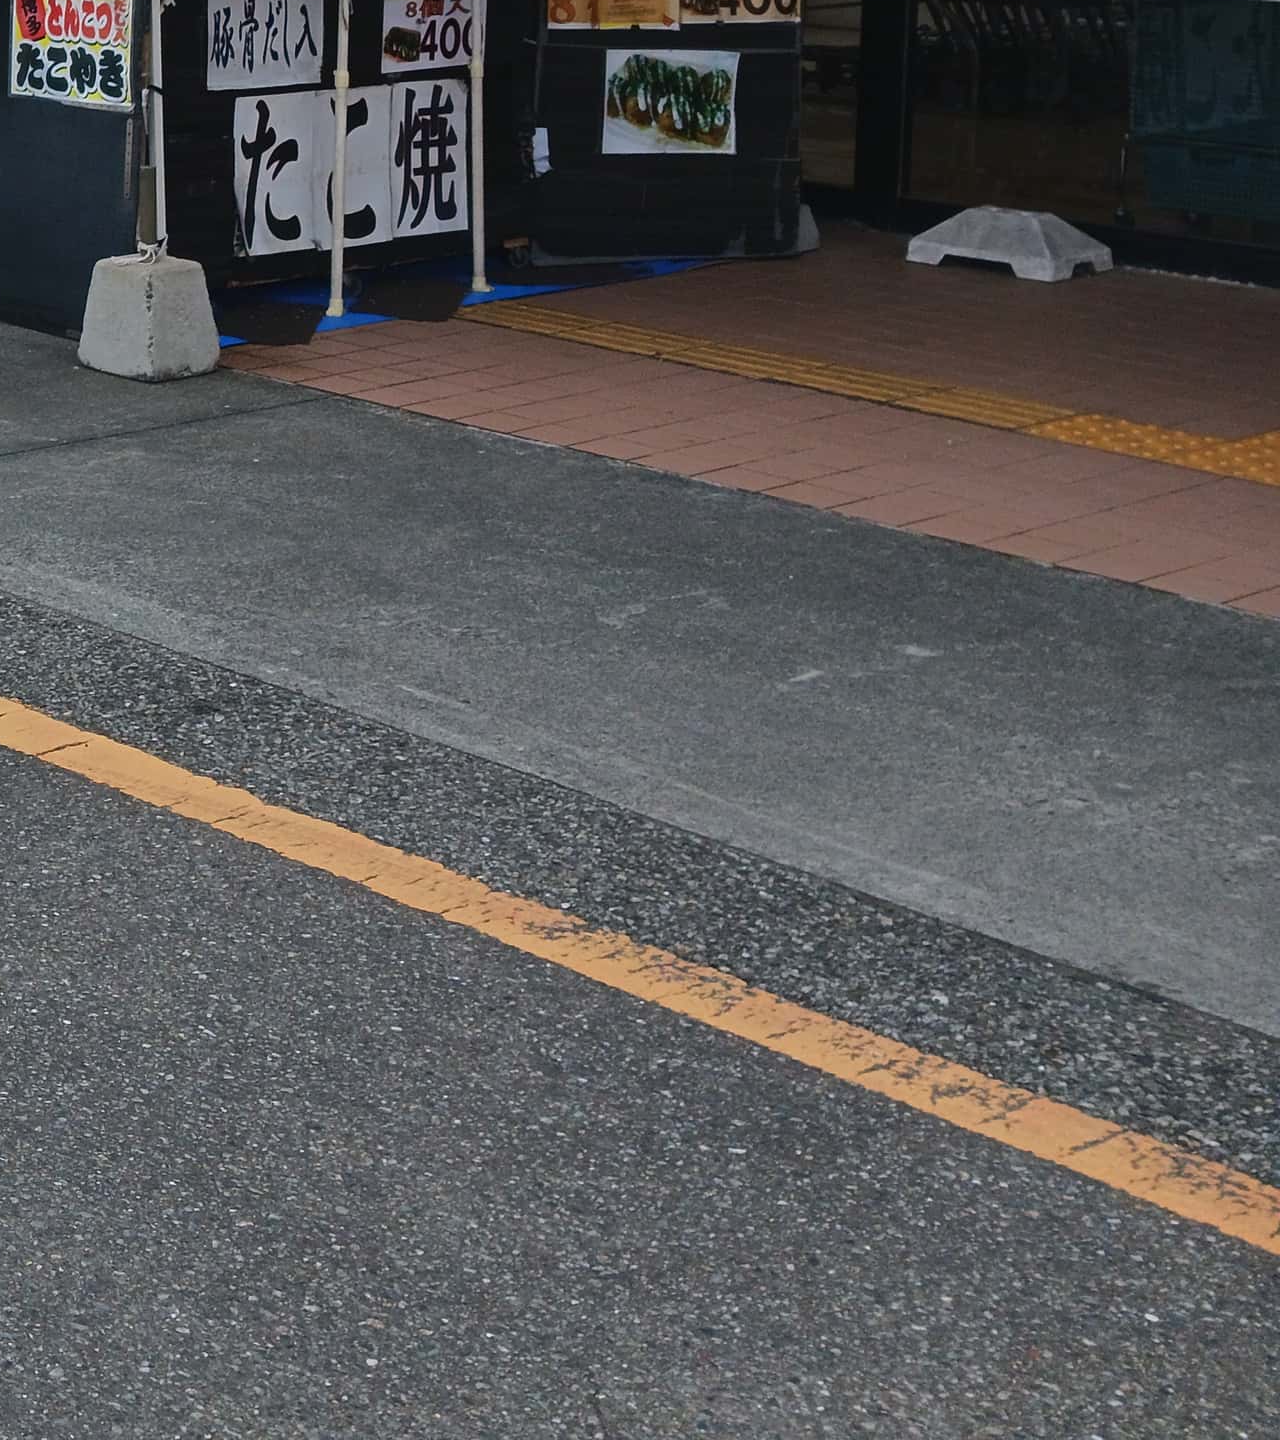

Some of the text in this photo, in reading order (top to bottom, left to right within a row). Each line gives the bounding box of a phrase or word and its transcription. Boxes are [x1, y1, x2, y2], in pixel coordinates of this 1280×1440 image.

[16, 43, 124, 98] たこやき
[240, 84, 458, 250] たこ焼
